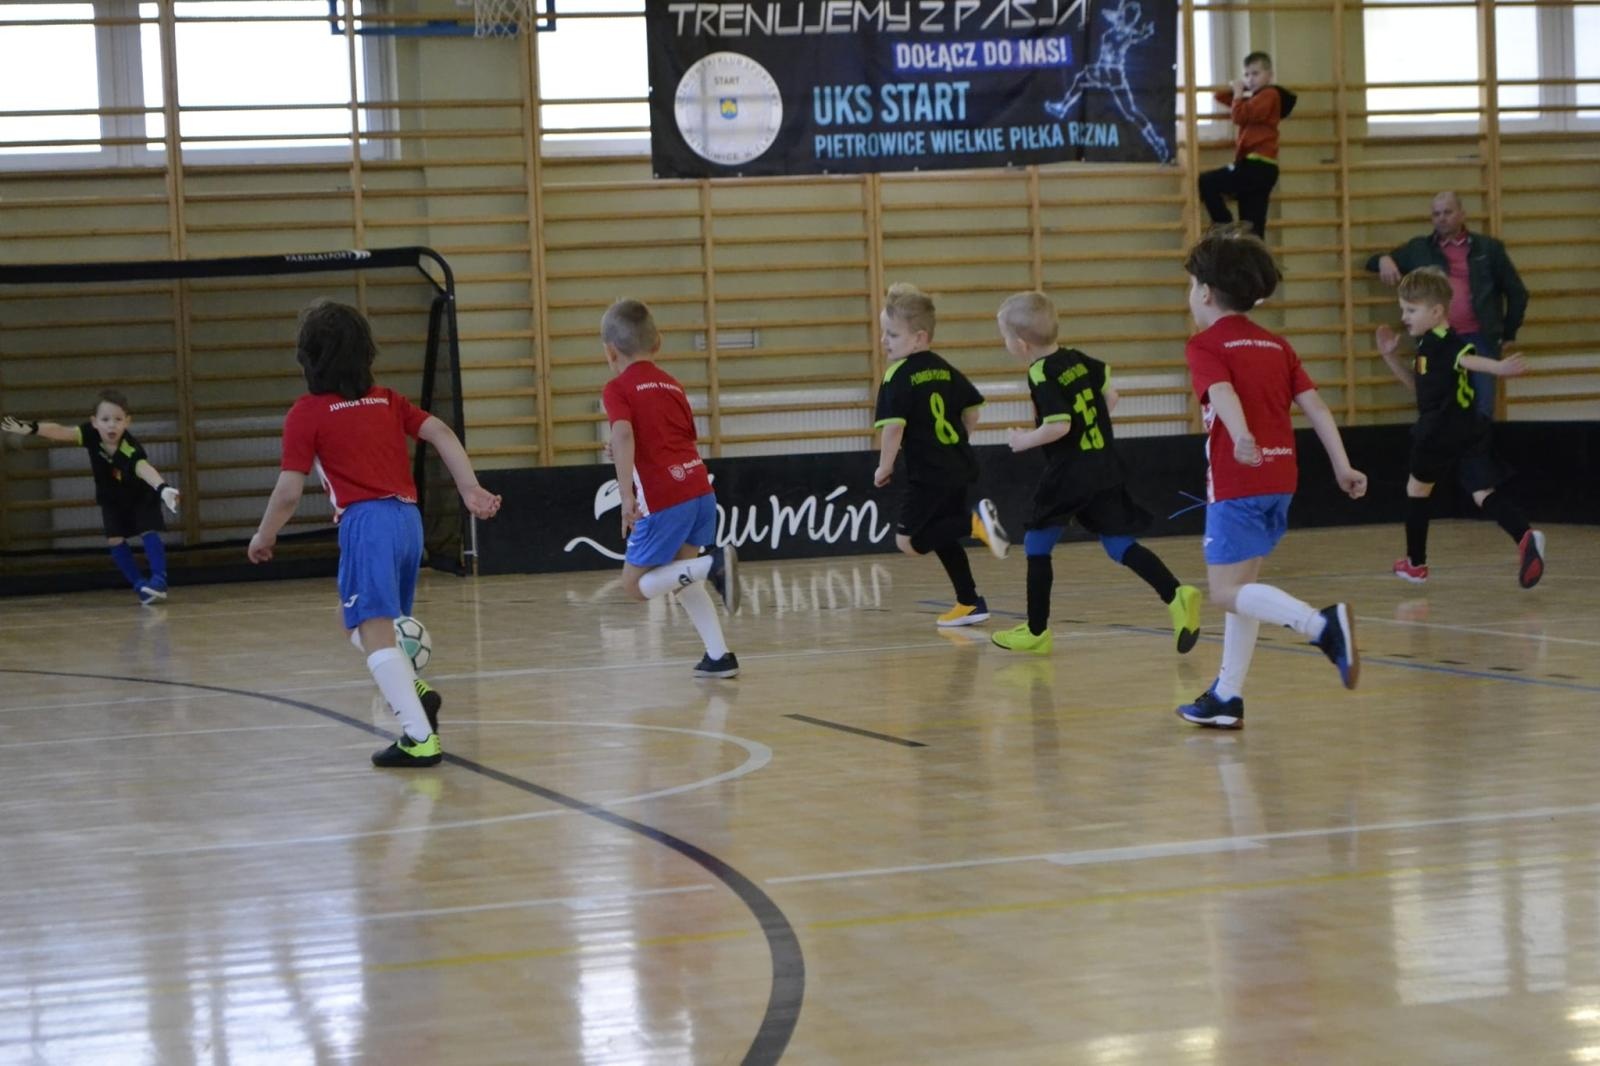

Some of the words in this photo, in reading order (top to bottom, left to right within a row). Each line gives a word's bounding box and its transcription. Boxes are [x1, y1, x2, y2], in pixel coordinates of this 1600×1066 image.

[668, 0, 910, 37] TRENUJEMY
[919, 1, 945, 33] Z
[896, 41, 977, 72] DOŁĄCZ
[984, 39, 1012, 66] DO
[1019, 37, 1067, 64] NAS!
[714, 75, 740, 86] START
[813, 84, 873, 126] UKS
[881, 81, 970, 123] START
[815, 131, 926, 159] PIETROWICE
[931, 127, 1005, 155] WIELKIE
[1010, 123, 1064, 150] PIŁKA
[329, 400, 360, 412] JUNIOR
[930, 391, 959, 445] 8
